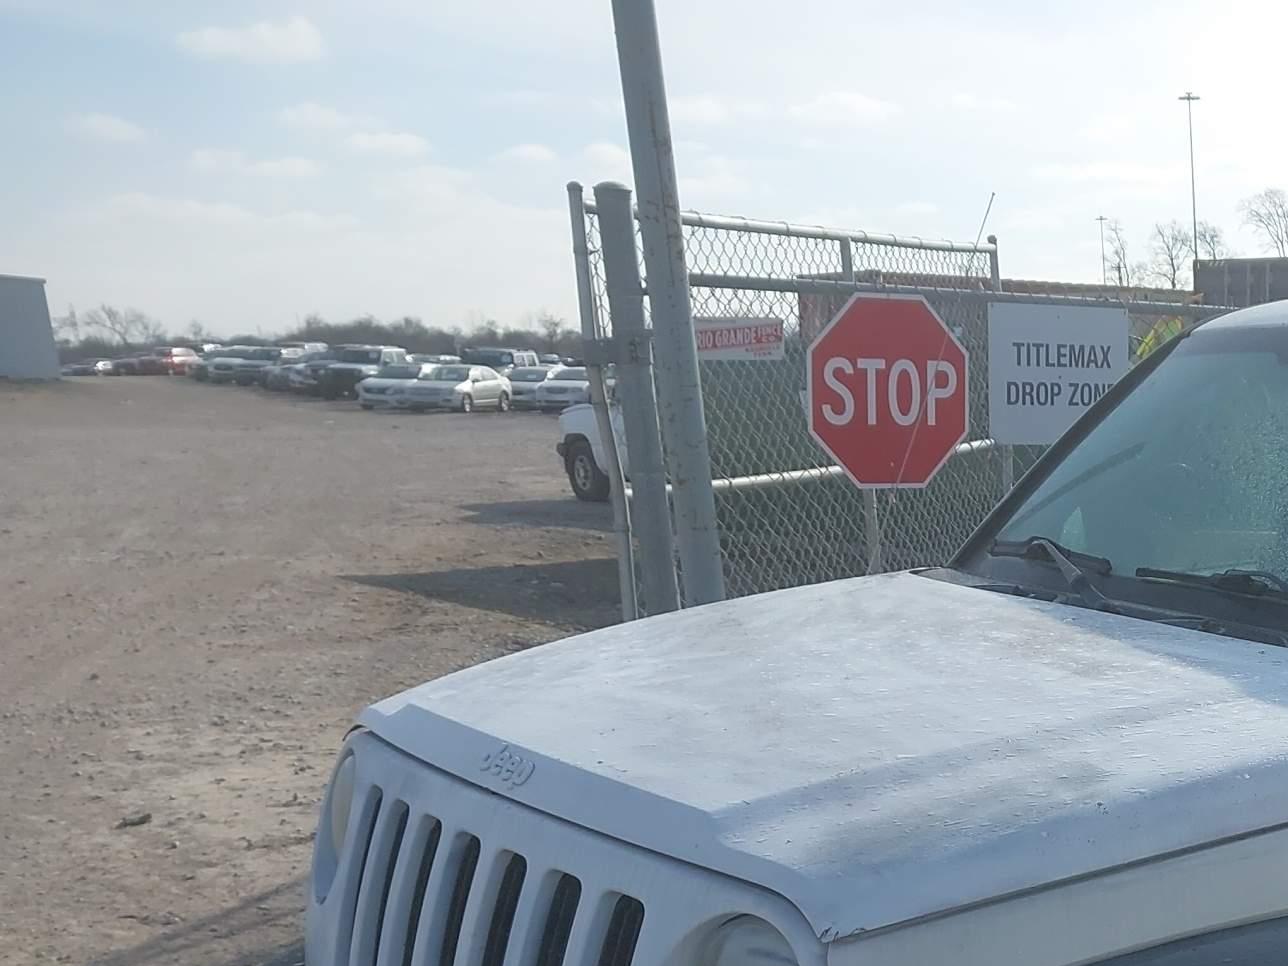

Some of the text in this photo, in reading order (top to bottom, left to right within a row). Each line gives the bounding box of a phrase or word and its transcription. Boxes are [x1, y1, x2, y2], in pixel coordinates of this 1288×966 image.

[715, 327, 757, 346] GRANDE
[1012, 342, 1112, 369] TITLEMAX
[821, 356, 958, 426] STOP
[1006, 381, 1115, 407] DROP ZON
[480, 743, 536, 789] Jeep
